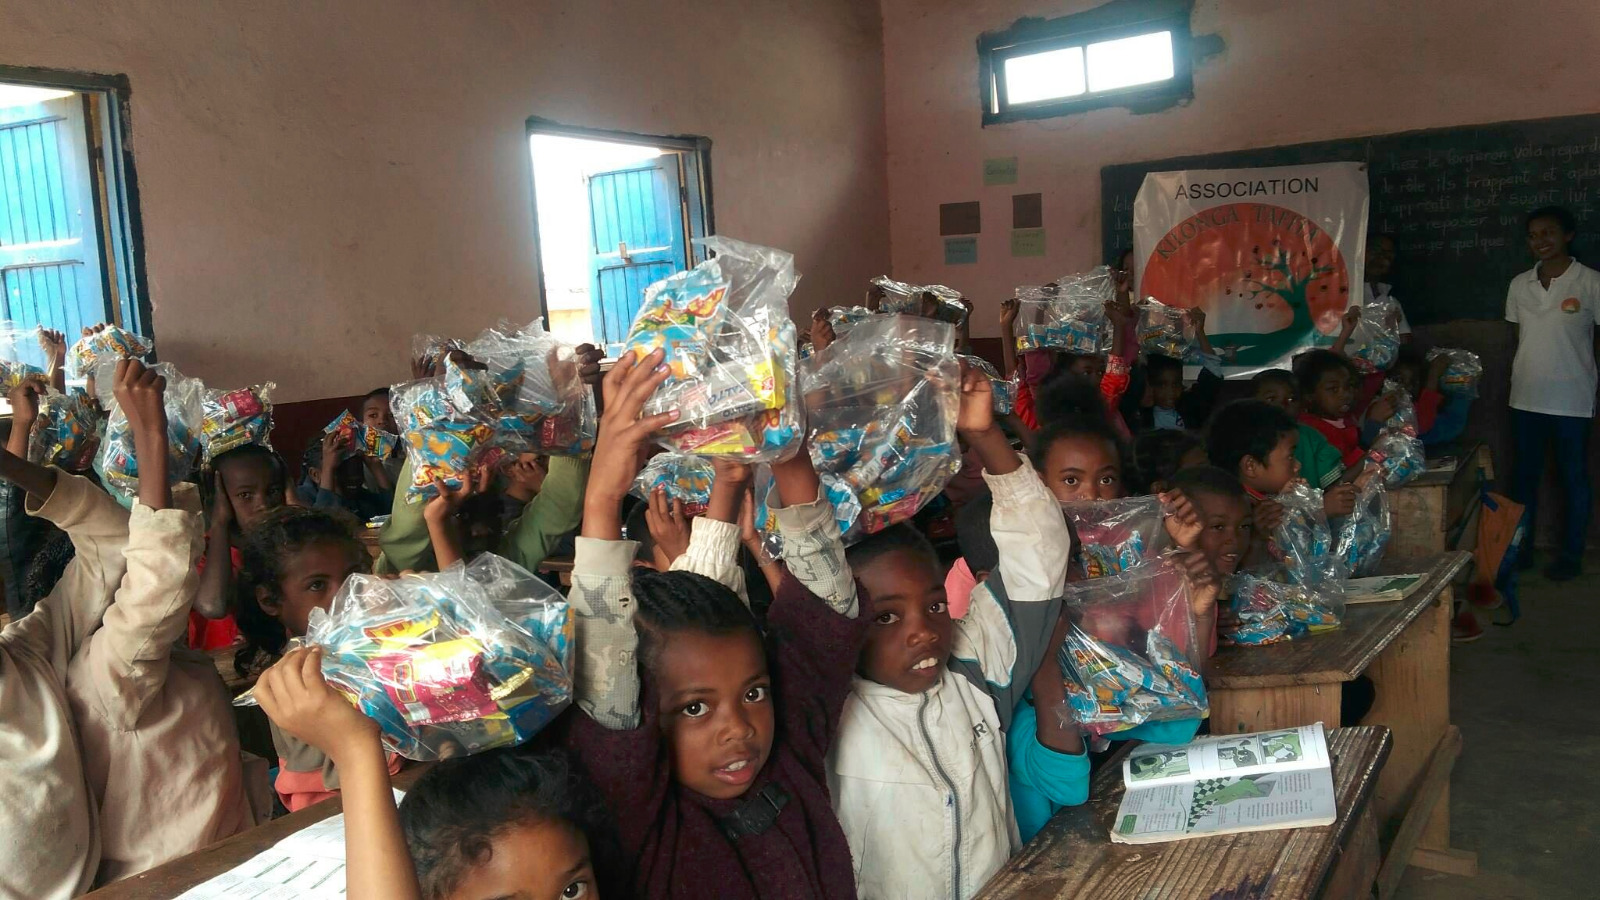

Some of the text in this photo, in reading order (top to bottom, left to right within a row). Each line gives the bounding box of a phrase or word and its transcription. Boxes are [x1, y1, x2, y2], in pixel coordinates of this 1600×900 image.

[1543, 162, 1559, 182] et
[1174, 177, 1319, 200] ASSOCIATION
[1464, 193, 1500, 210] tout
[1156, 205, 1240, 260] KILONGA
[1426, 216, 1488, 237] reposer
[1500, 214, 1518, 227] un
[1450, 232, 1506, 255] quelque
[707, 381, 748, 405] SALTO
[722, 403, 754, 418] SALTO
